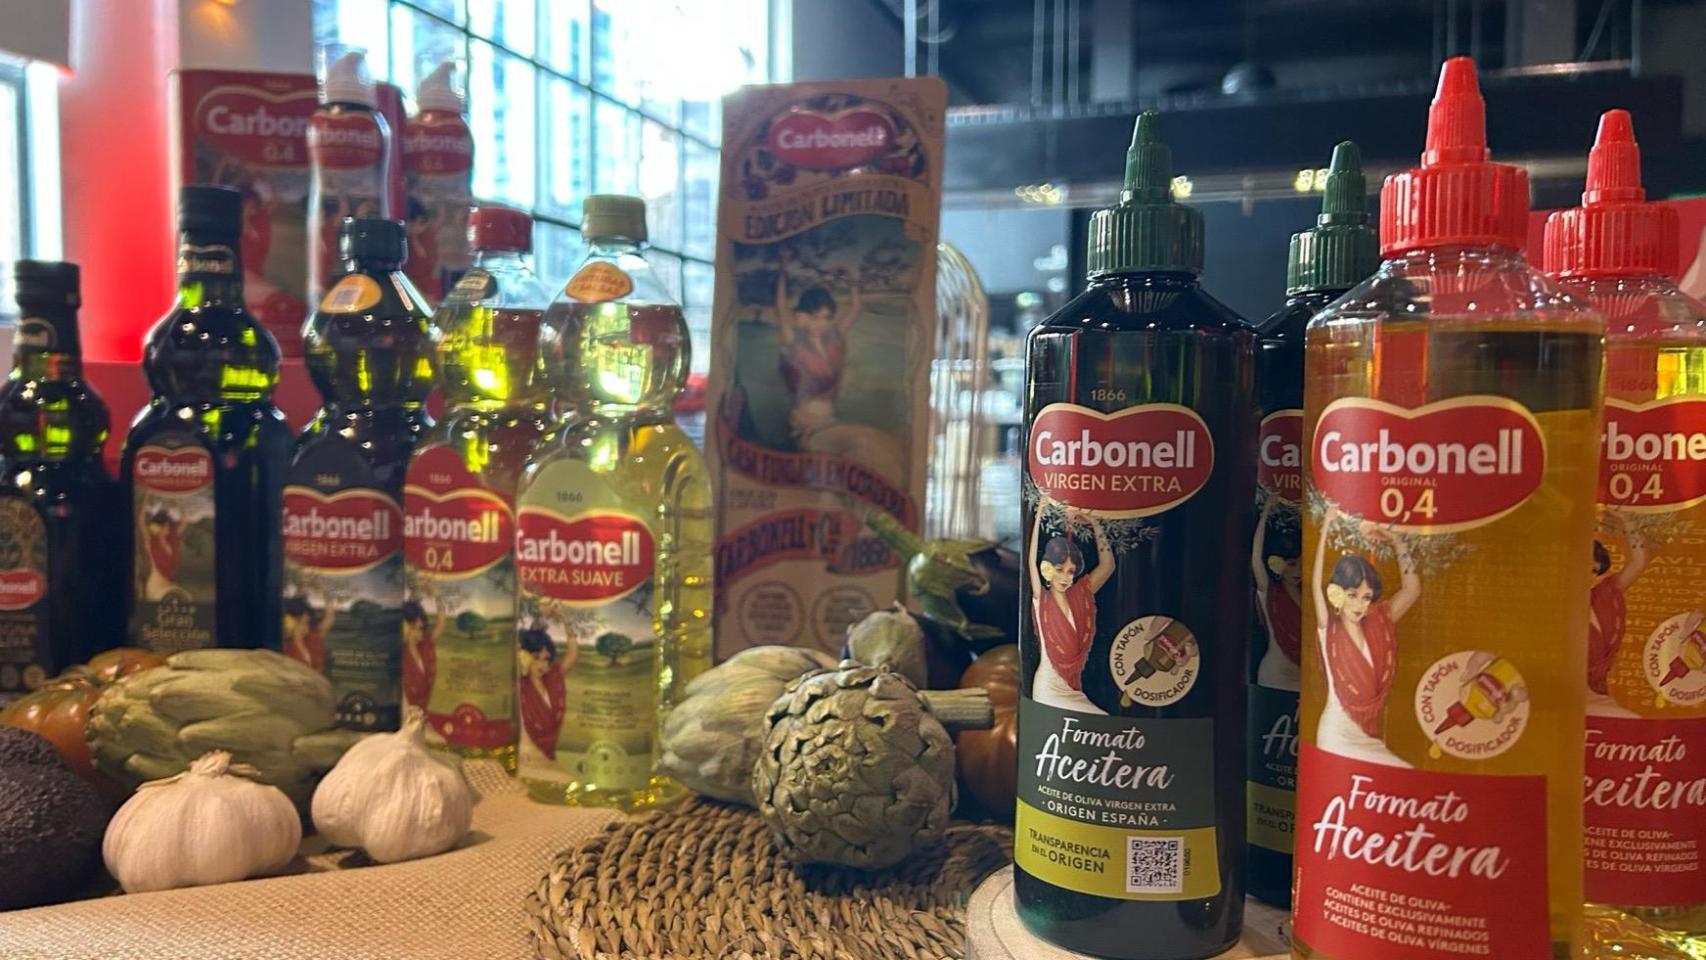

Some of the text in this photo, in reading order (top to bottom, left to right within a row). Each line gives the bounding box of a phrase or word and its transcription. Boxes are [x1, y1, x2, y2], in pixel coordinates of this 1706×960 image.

[206, 105, 309, 137] Carbon
[778, 125, 887, 148] Carbonell
[1091, 389, 1126, 401] 1866
[1035, 429, 1195, 468] Carbonell
[1320, 429, 1523, 475] Carbonell
[138, 458, 208, 477] Carbonell
[1044, 472, 1182, 492] VIRGEN EXTRA
[1381, 476, 1438, 487] ORIGINAL
[1610, 463, 1663, 472] ORIGINAL
[556, 489, 583, 502] 1866
[1609, 472, 1664, 503] 0,4
[1380, 488, 1438, 522] 0,4
[404, 507, 499, 543] arbonell
[521, 566, 624, 587] EXTRA SUAVE
[1115, 623, 1145, 676] CON TAPÓN
[1134, 669, 1193, 701] DOSIFICADOR
[1421, 696, 1435, 723] CON
[1061, 717, 1145, 750] Formato
[1446, 717, 1520, 753] DOSIFICADOR
[1035, 733, 1175, 790] Aceitera
[1038, 784, 1176, 812] ACEITE DE OLIVA VIRGEN EXTRA
[1348, 775, 1468, 822] Formato
[1584, 765, 1706, 810] ceitera
[1047, 799, 1159, 826] ORIGEN ESPAÑA
[1029, 828, 1111, 860] TRANSPARENCIA
[1313, 796, 1511, 879] Aceitera
[1585, 826, 1618, 837] CEITE
[1621, 829, 1635, 839] DE
[1049, 849, 1105, 874] ORIGEN
[1592, 849, 1607, 859] DE
[1610, 851, 1643, 861] OLIVA
[1601, 861, 1617, 871] DE
[1619, 863, 1652, 873] OLIVA
[1326, 887, 1487, 929] CONTIENE EXCLUSIVAMENTE
[1351, 883, 1387, 900] ACEITE
[1390, 893, 1404, 904] DE
[1323, 898, 1489, 942] ACEITES DE OLIVA REFINADOS
[1330, 915, 1369, 934] ACEITES
[1370, 926, 1386, 939] DE
[1388, 930, 1425, 948] OLIVA
